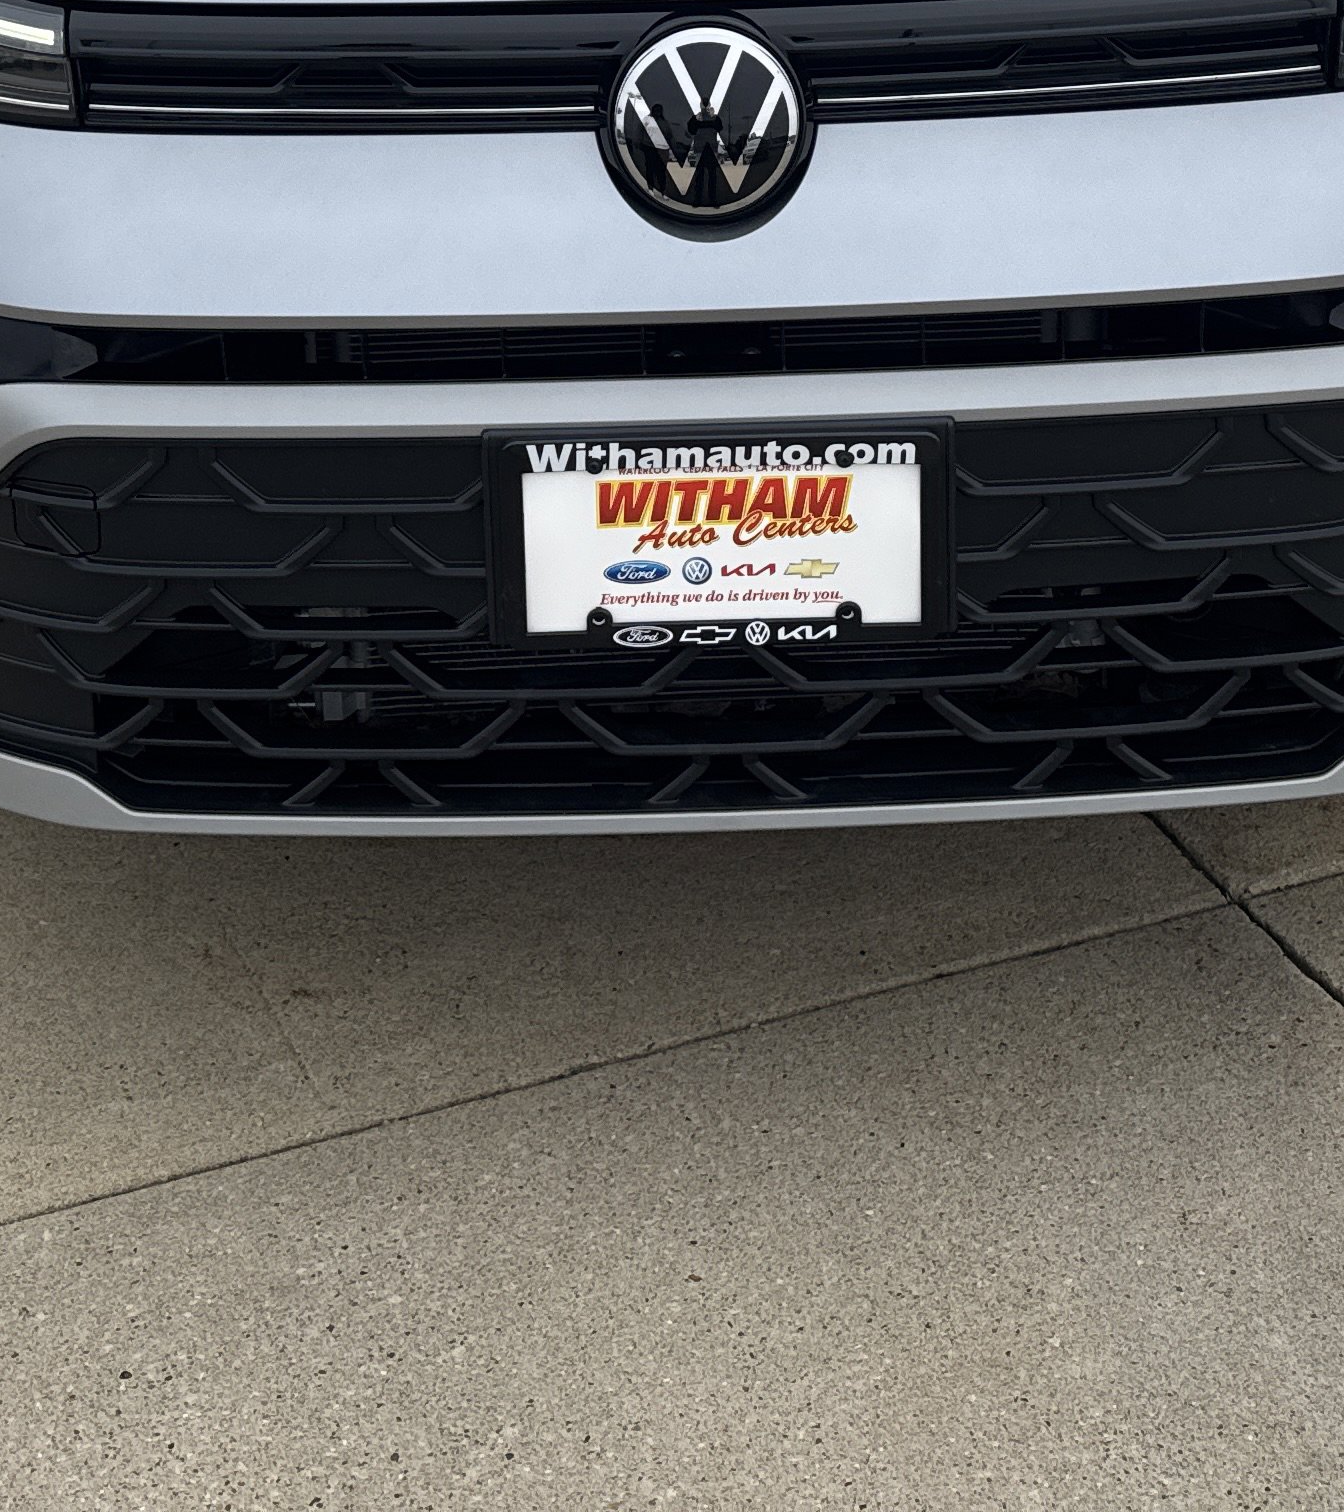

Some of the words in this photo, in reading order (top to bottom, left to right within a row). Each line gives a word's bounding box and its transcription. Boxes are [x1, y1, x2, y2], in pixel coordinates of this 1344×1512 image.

[526, 440, 917, 474] Withamauto.com
[596, 474, 853, 528] WITHAM
[633, 519, 719, 553] Auto
[733, 510, 858, 548] Centers
[600, 592, 680, 607] Everything
[683, 593, 703, 603] we
[706, 590, 724, 602] do
[728, 590, 739, 602] is
[742, 589, 789, 602] driven
[793, 588, 810, 604] by
[812, 590, 843, 604] you.
